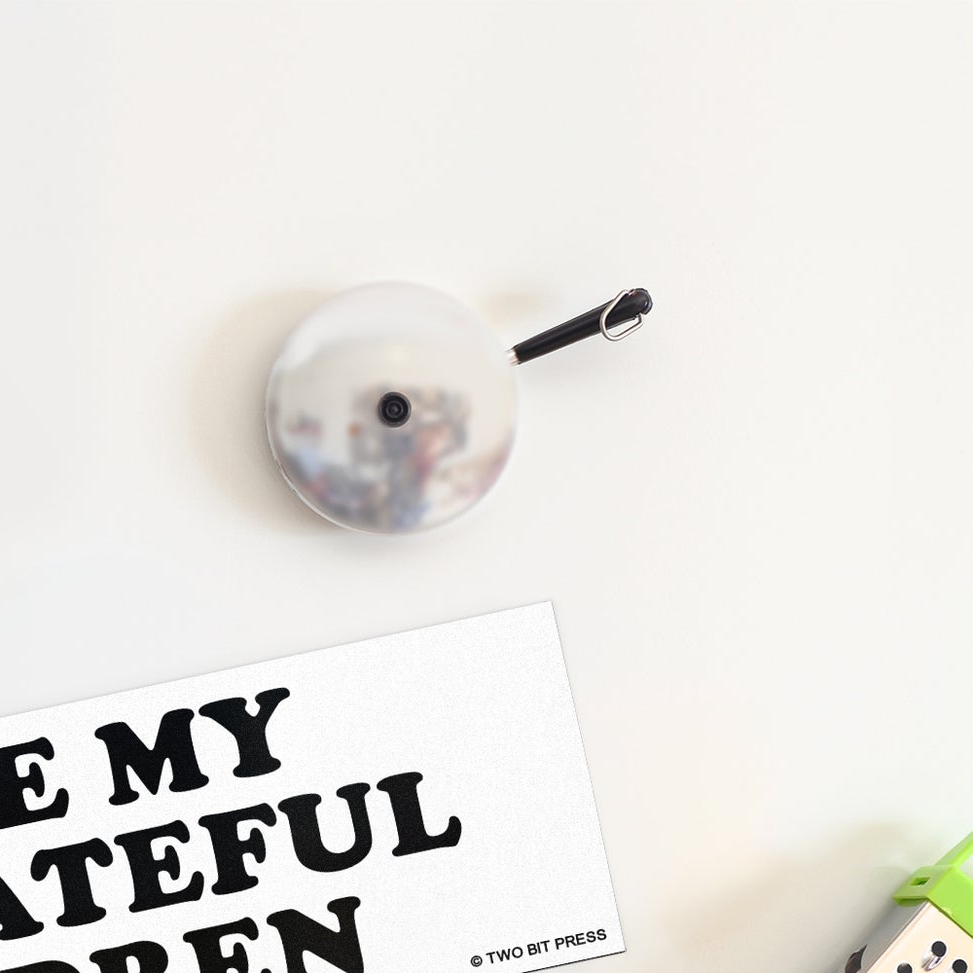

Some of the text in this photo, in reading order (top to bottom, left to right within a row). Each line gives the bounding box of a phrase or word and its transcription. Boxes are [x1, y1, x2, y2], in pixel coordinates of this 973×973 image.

[94, 687, 291, 806] MY
[486, 946, 524, 964] TWO
[526, 940, 551, 956] BIT
[554, 928, 608, 950] PRESS
